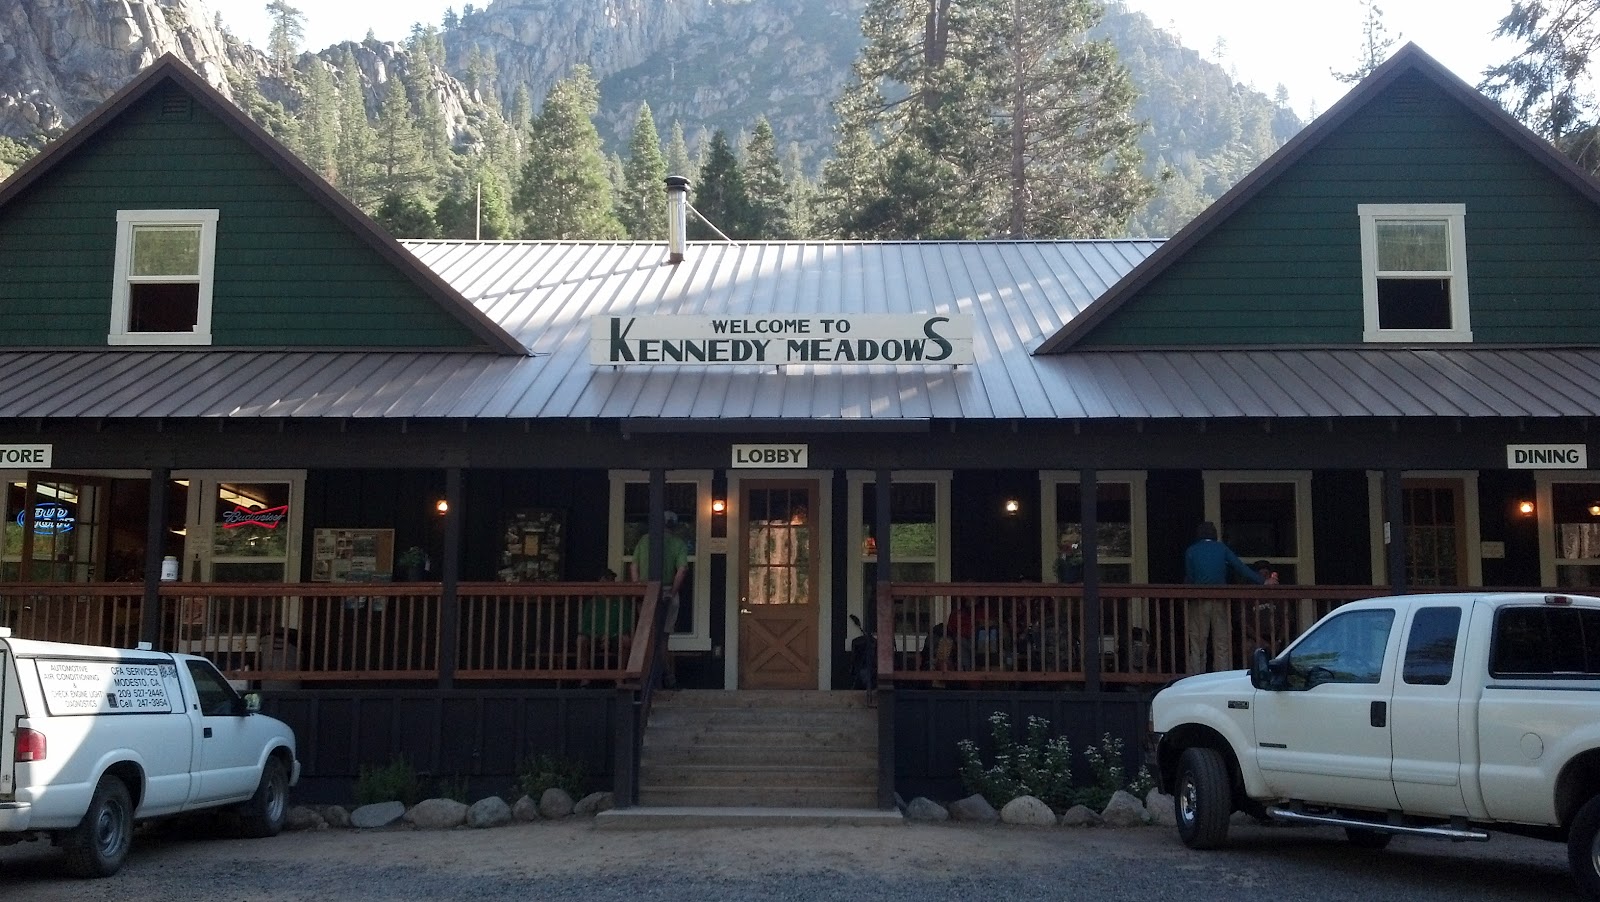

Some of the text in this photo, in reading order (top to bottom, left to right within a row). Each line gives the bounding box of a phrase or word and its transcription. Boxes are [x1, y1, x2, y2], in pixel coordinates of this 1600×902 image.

[712, 318, 851, 334] WELCOME TO
[609, 316, 953, 362] KENNEDY MEADOWS
[736, 449, 804, 464] LOBBY
[1514, 448, 1580, 464] DINING
[222, 510, 286, 523] Budweiser
[50, 664, 88, 672] AUTOMOTIVE
[110, 666, 158, 676] CFA SERVICES
[56, 673, 100, 681] CONDITIONING
[70, 690, 88, 698] ENGINE
[89, 690, 104, 698] LIGHT
[117, 689, 131, 698] 209
[65, 700, 97, 708] DIAGNOSTICS
[119, 699, 133, 708] Cell
